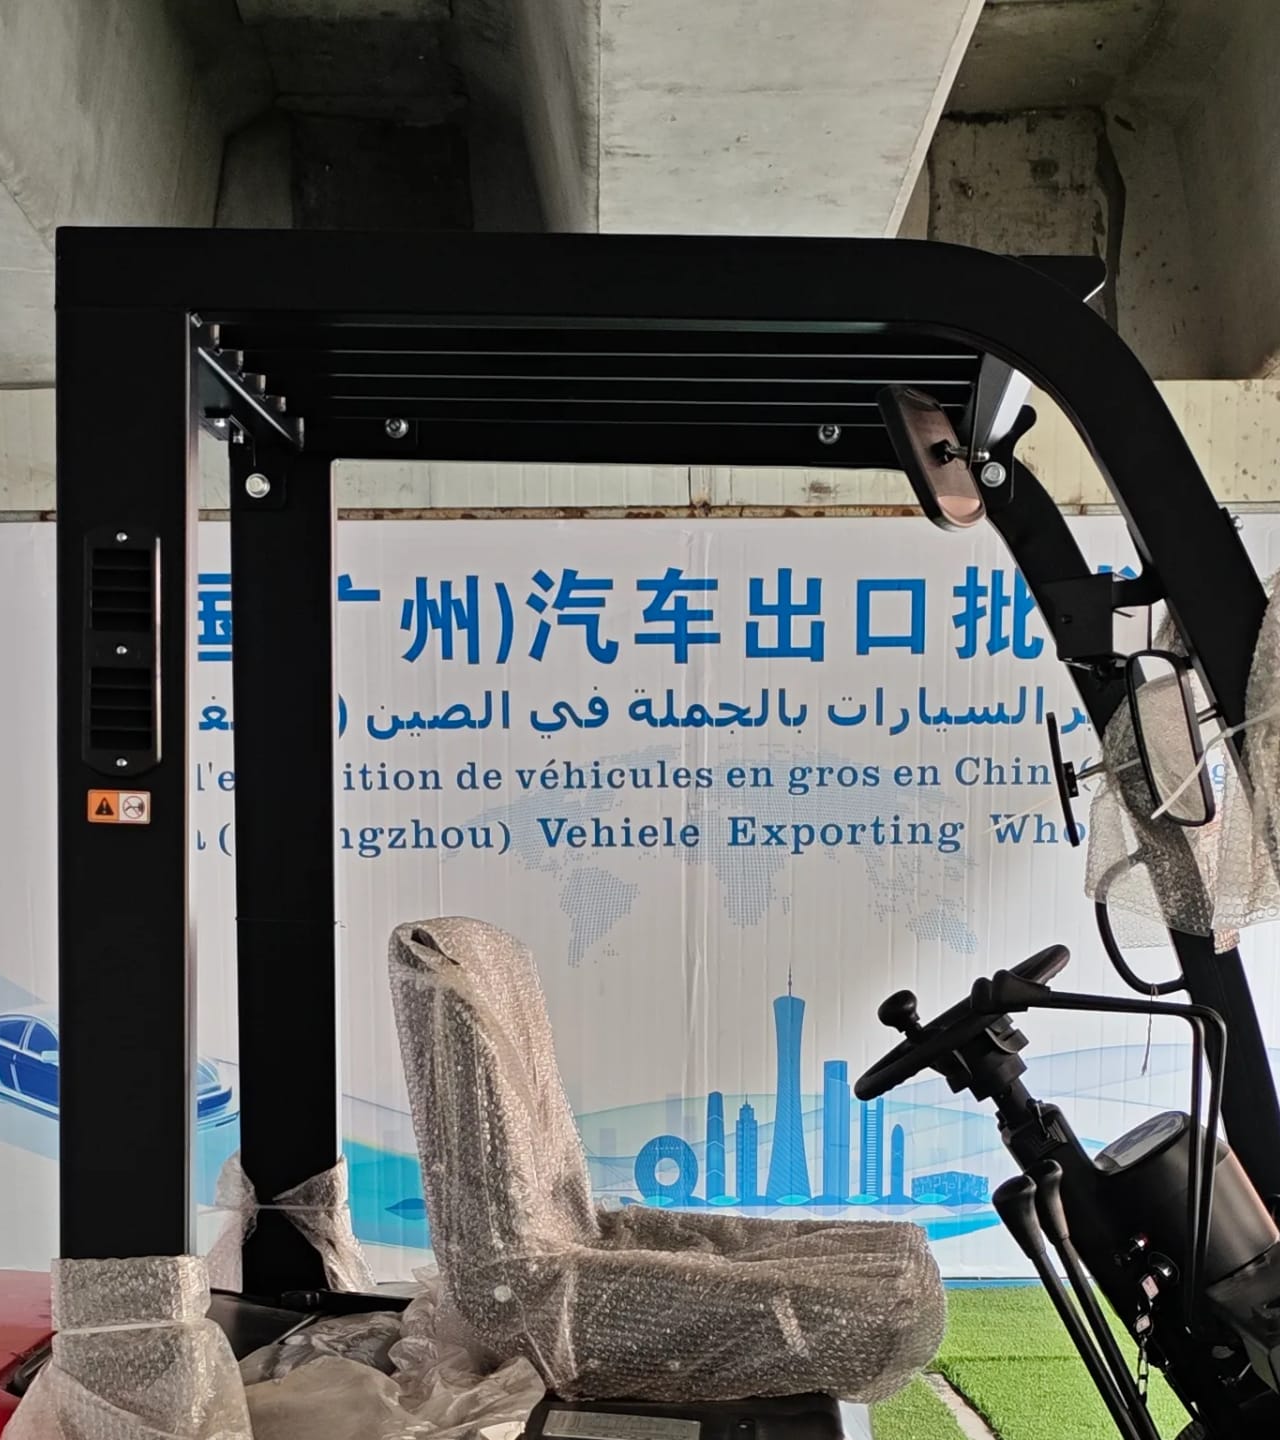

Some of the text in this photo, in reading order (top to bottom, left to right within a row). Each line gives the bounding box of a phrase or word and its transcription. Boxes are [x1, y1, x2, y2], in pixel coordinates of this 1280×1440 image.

[366, 690, 510, 739] الصين
[530, 686, 609, 738] في
[628, 688, 808, 735] بالجملة
[827, 685, 1044, 735] السيارات
[456, 761, 502, 790] de
[515, 758, 713, 790] véhicules
[726, 763, 774, 788] en
[787, 762, 880, 796] gros
[893, 762, 941, 787] en
[537, 817, 700, 848] Vehiele
[727, 814, 964, 853] Exporting
